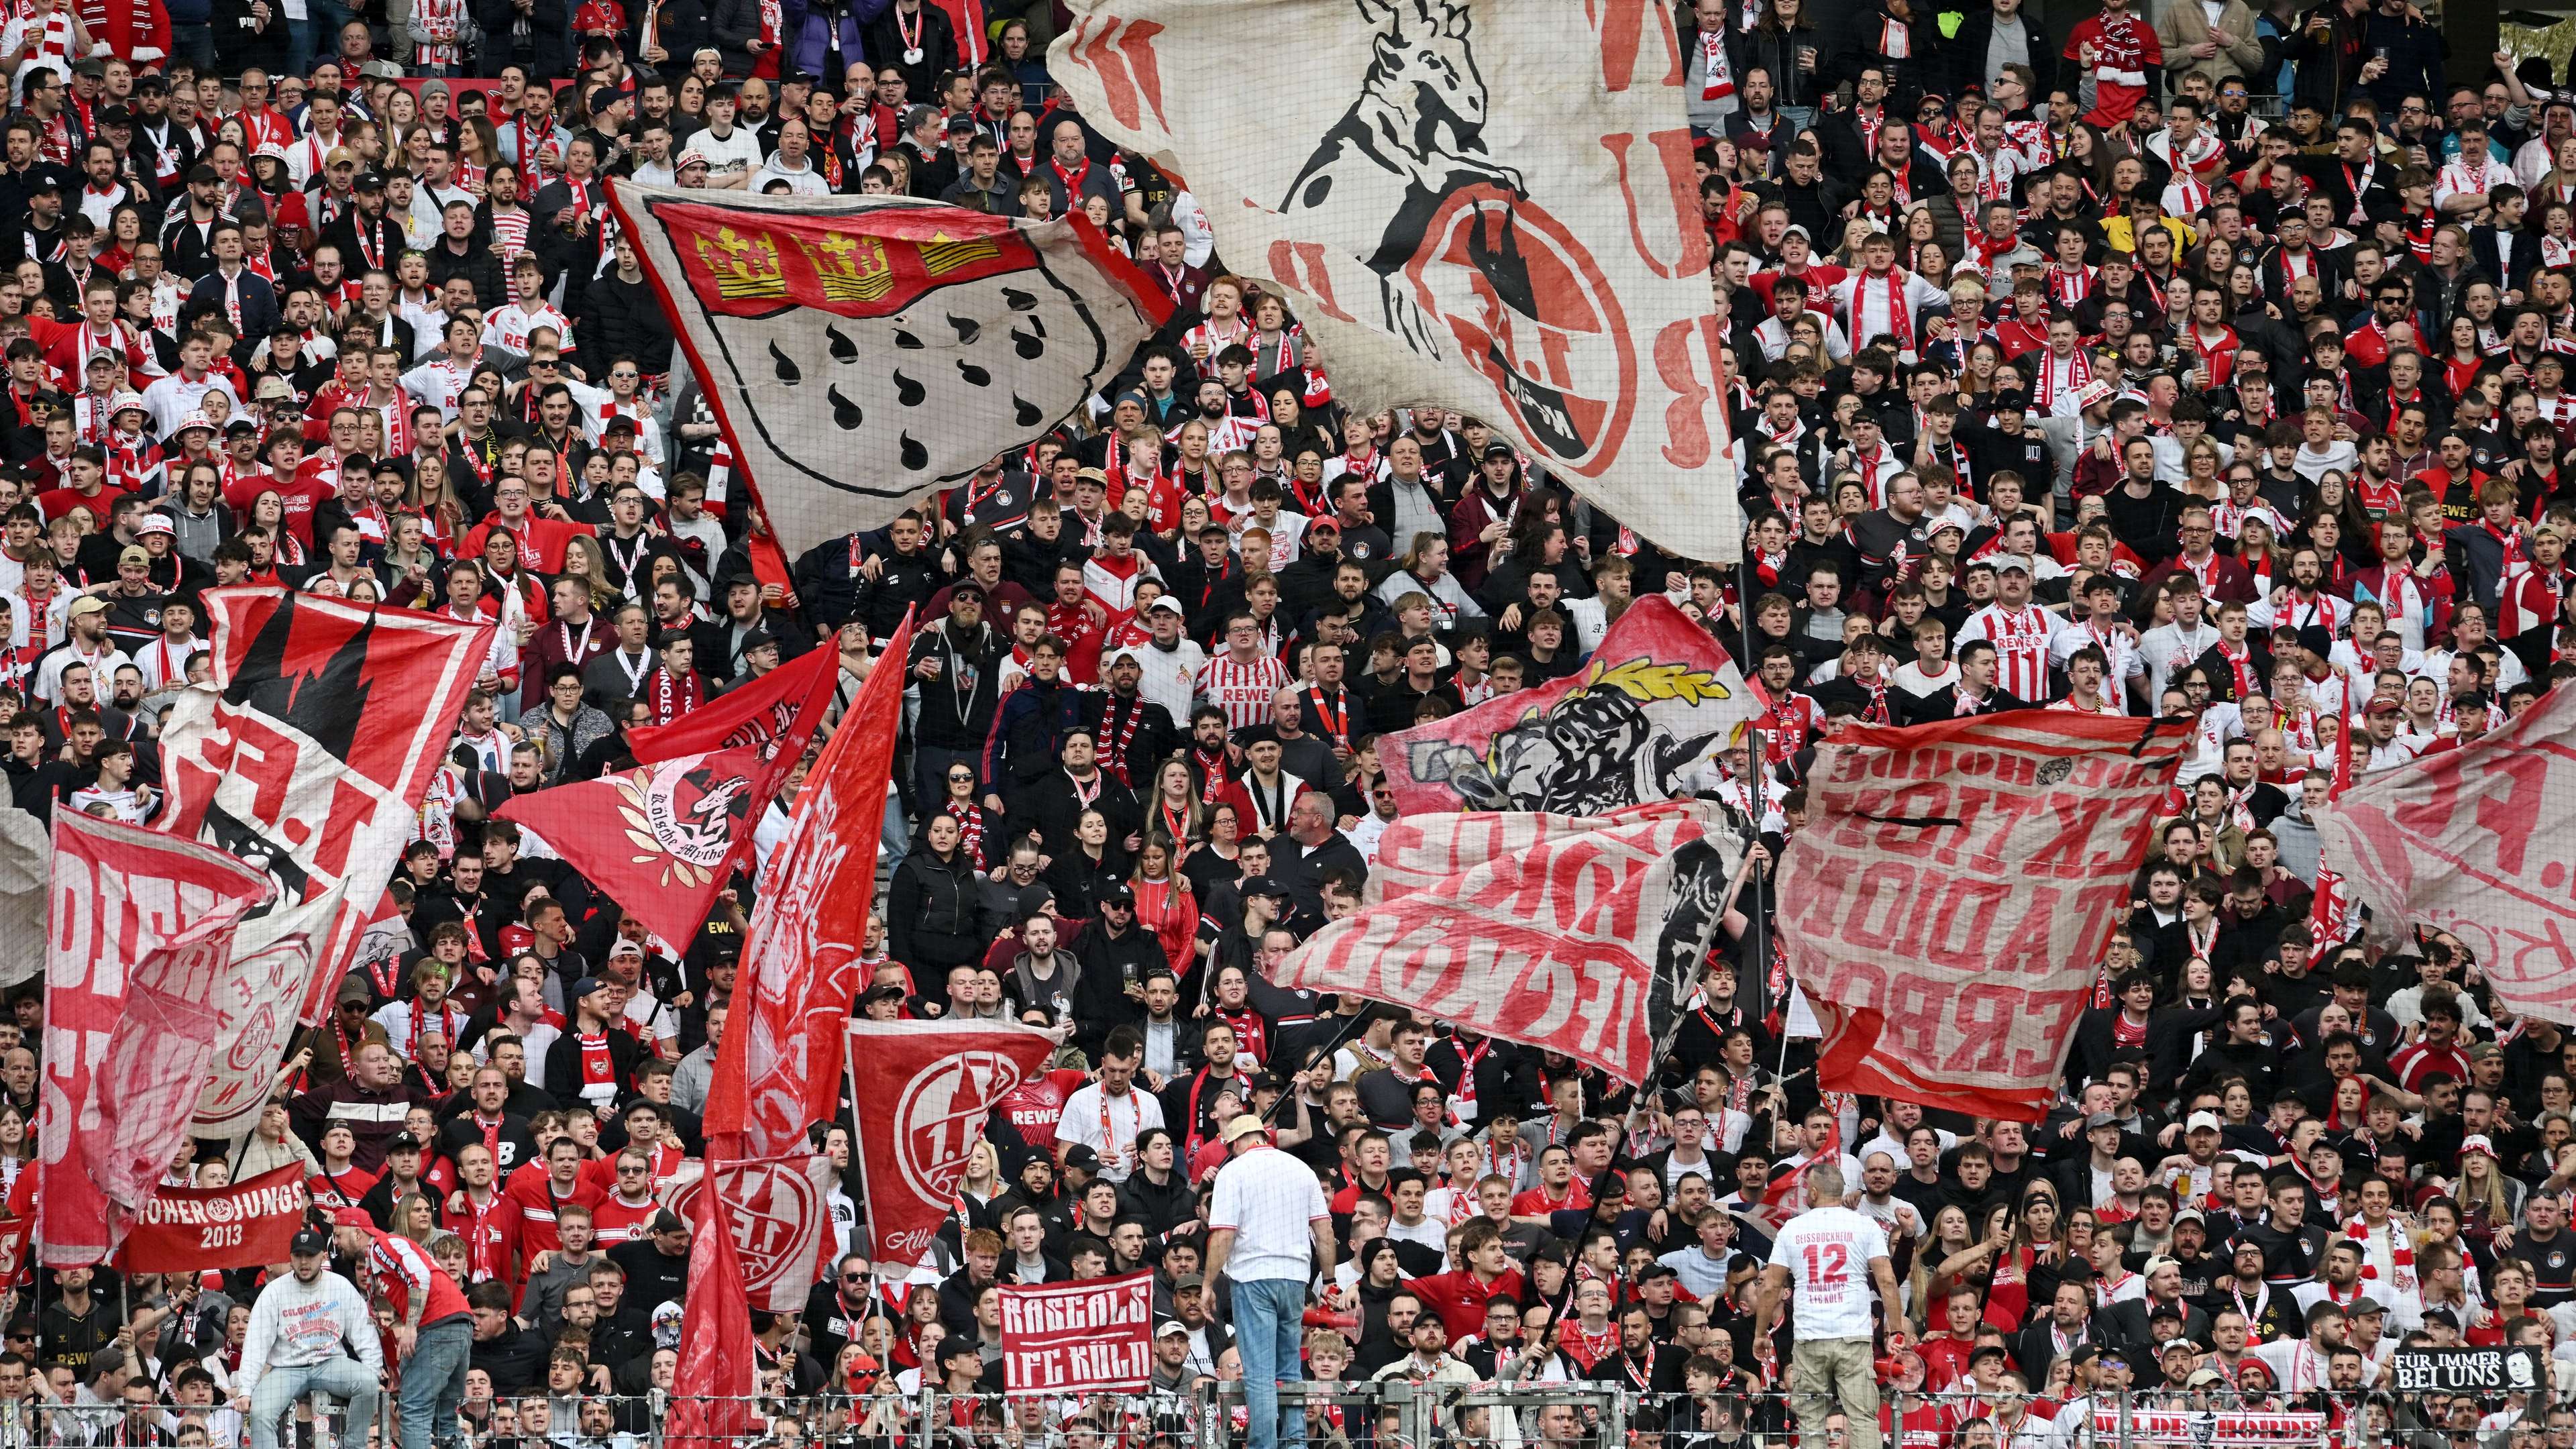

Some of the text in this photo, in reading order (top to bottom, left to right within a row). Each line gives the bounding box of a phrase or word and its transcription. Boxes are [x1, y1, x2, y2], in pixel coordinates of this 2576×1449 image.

[239, 17, 256, 28] PU
[2441, 504, 2468, 517] EWE
[1223, 688, 1269, 702] REWE
[651, 793, 725, 862] Kölsche Mytho
[1012, 1109, 1060, 1125] REWE
[232, 1180, 303, 1222] JUNGS
[201, 1224, 243, 1248] 2013
[1803, 1244, 1847, 1284] 12
[1002, 1285, 1147, 1334] RASCALS
[1068, 1340, 1150, 1382] KÖLN
[2394, 1351, 2503, 1369] FÜR IMMER
[2396, 1364, 2501, 1389] BEI UNS
[2217, 1419, 2319, 1439] HORDE
